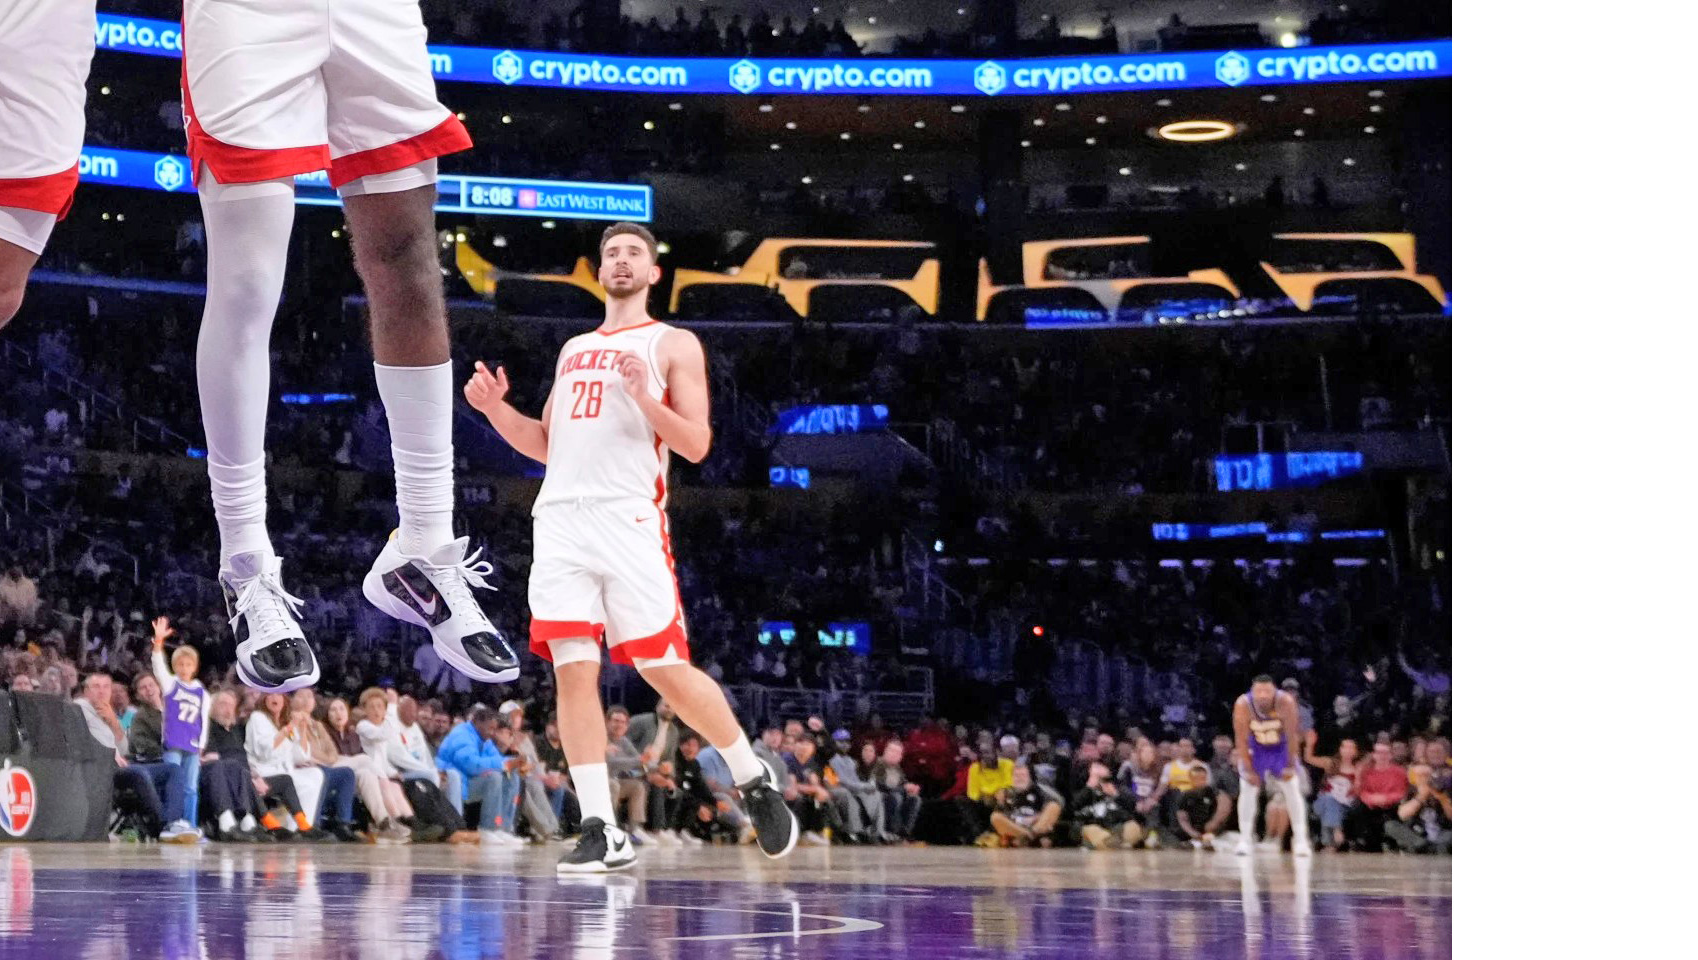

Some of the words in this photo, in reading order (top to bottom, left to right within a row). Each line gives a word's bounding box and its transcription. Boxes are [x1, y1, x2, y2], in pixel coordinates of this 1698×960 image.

[530, 60, 687, 85] crypto.com
[1013, 62, 1186, 91] crypto.com
[1257, 47, 1436, 80] crypto.com
[768, 64, 932, 91] crypto.com
[471, 185, 514, 207] 8:08
[571, 381, 603, 419] 28
[178, 702, 199, 724] 77
